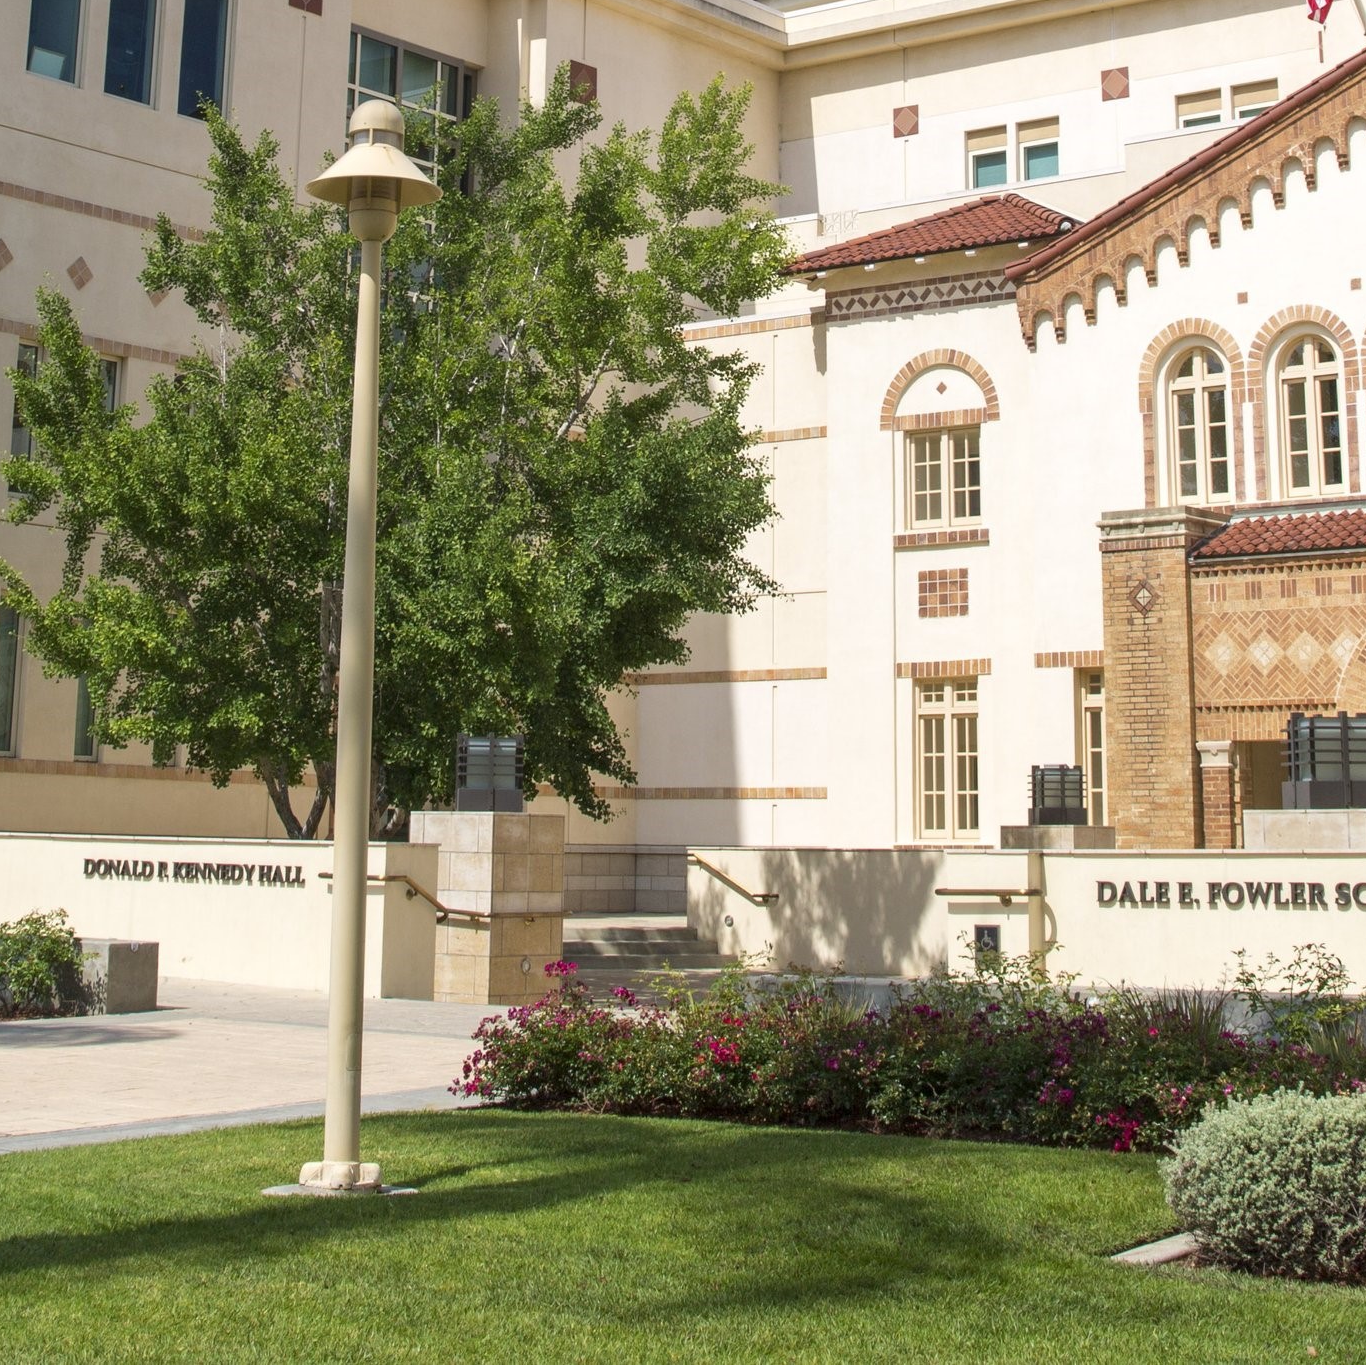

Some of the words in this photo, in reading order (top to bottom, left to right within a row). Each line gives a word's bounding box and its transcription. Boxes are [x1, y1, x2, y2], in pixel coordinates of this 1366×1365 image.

[83, 858, 155, 879] DONALD
[172, 861, 256, 882] KENNEDY
[257, 864, 306, 885] HALL
[1096, 880, 1171, 907] DALE
[1178, 881, 1201, 909] E.
[1208, 881, 1328, 909] FOWLER
